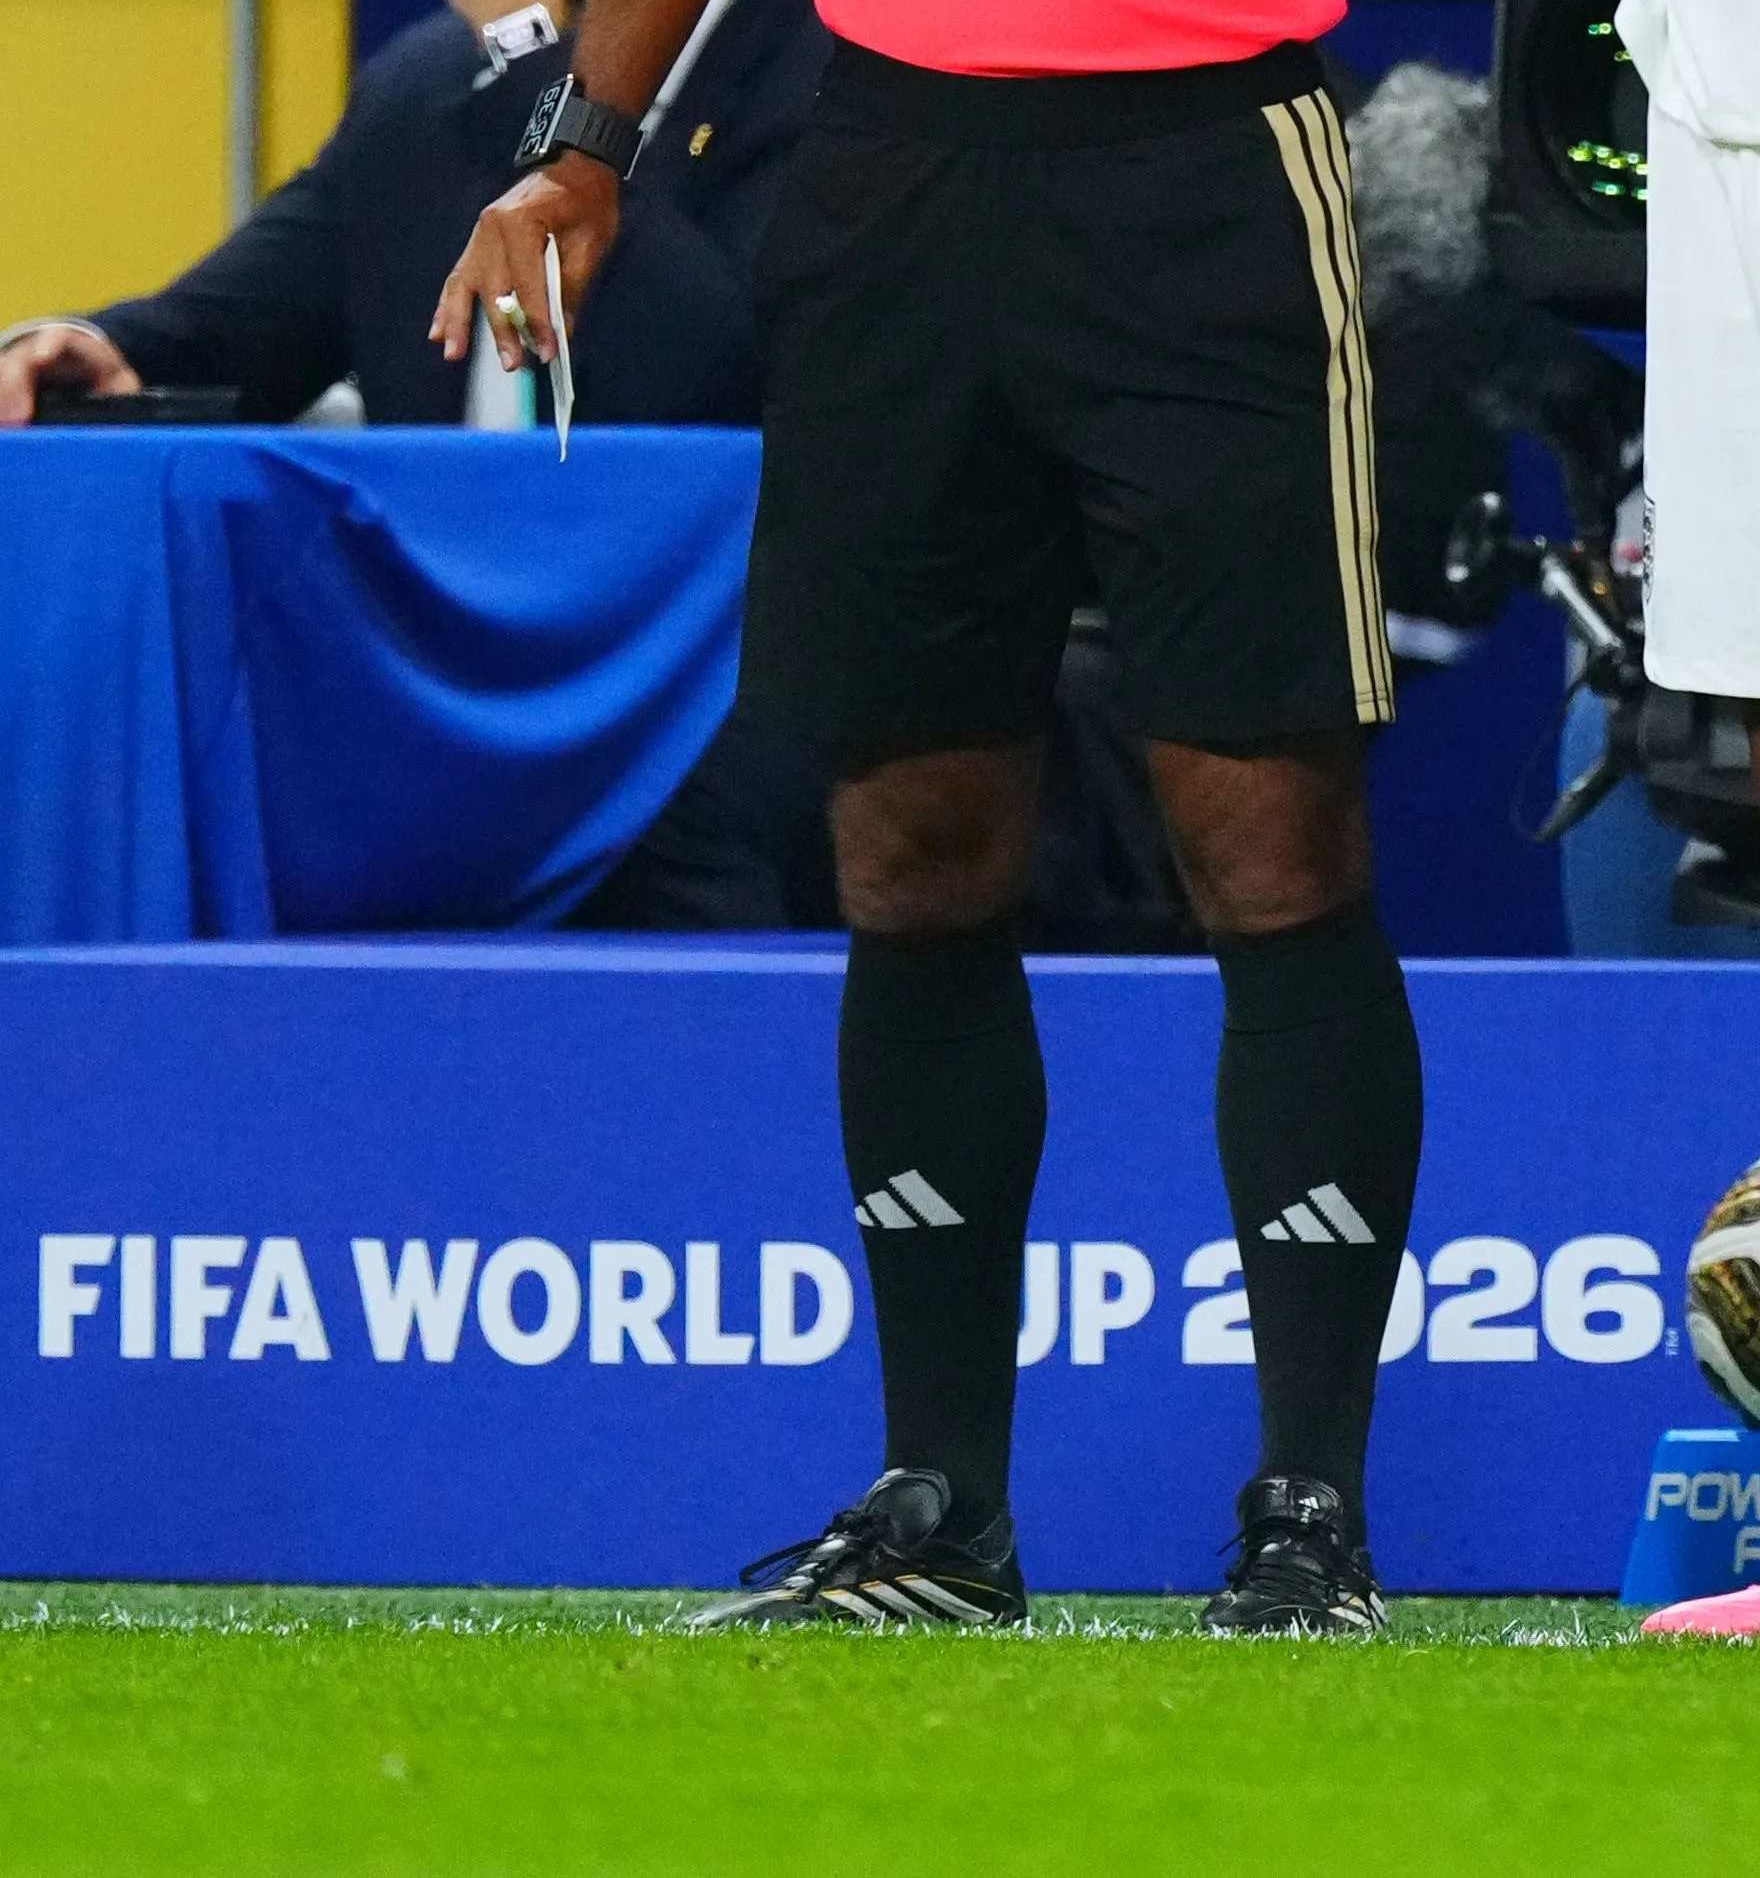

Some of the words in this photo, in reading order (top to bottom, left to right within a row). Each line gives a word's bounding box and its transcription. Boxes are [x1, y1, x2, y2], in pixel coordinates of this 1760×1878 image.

[37, 1233, 332, 1362] FIFA
[350, 1237, 855, 1366] WORLD
[1181, 1232, 1664, 1364] 226
